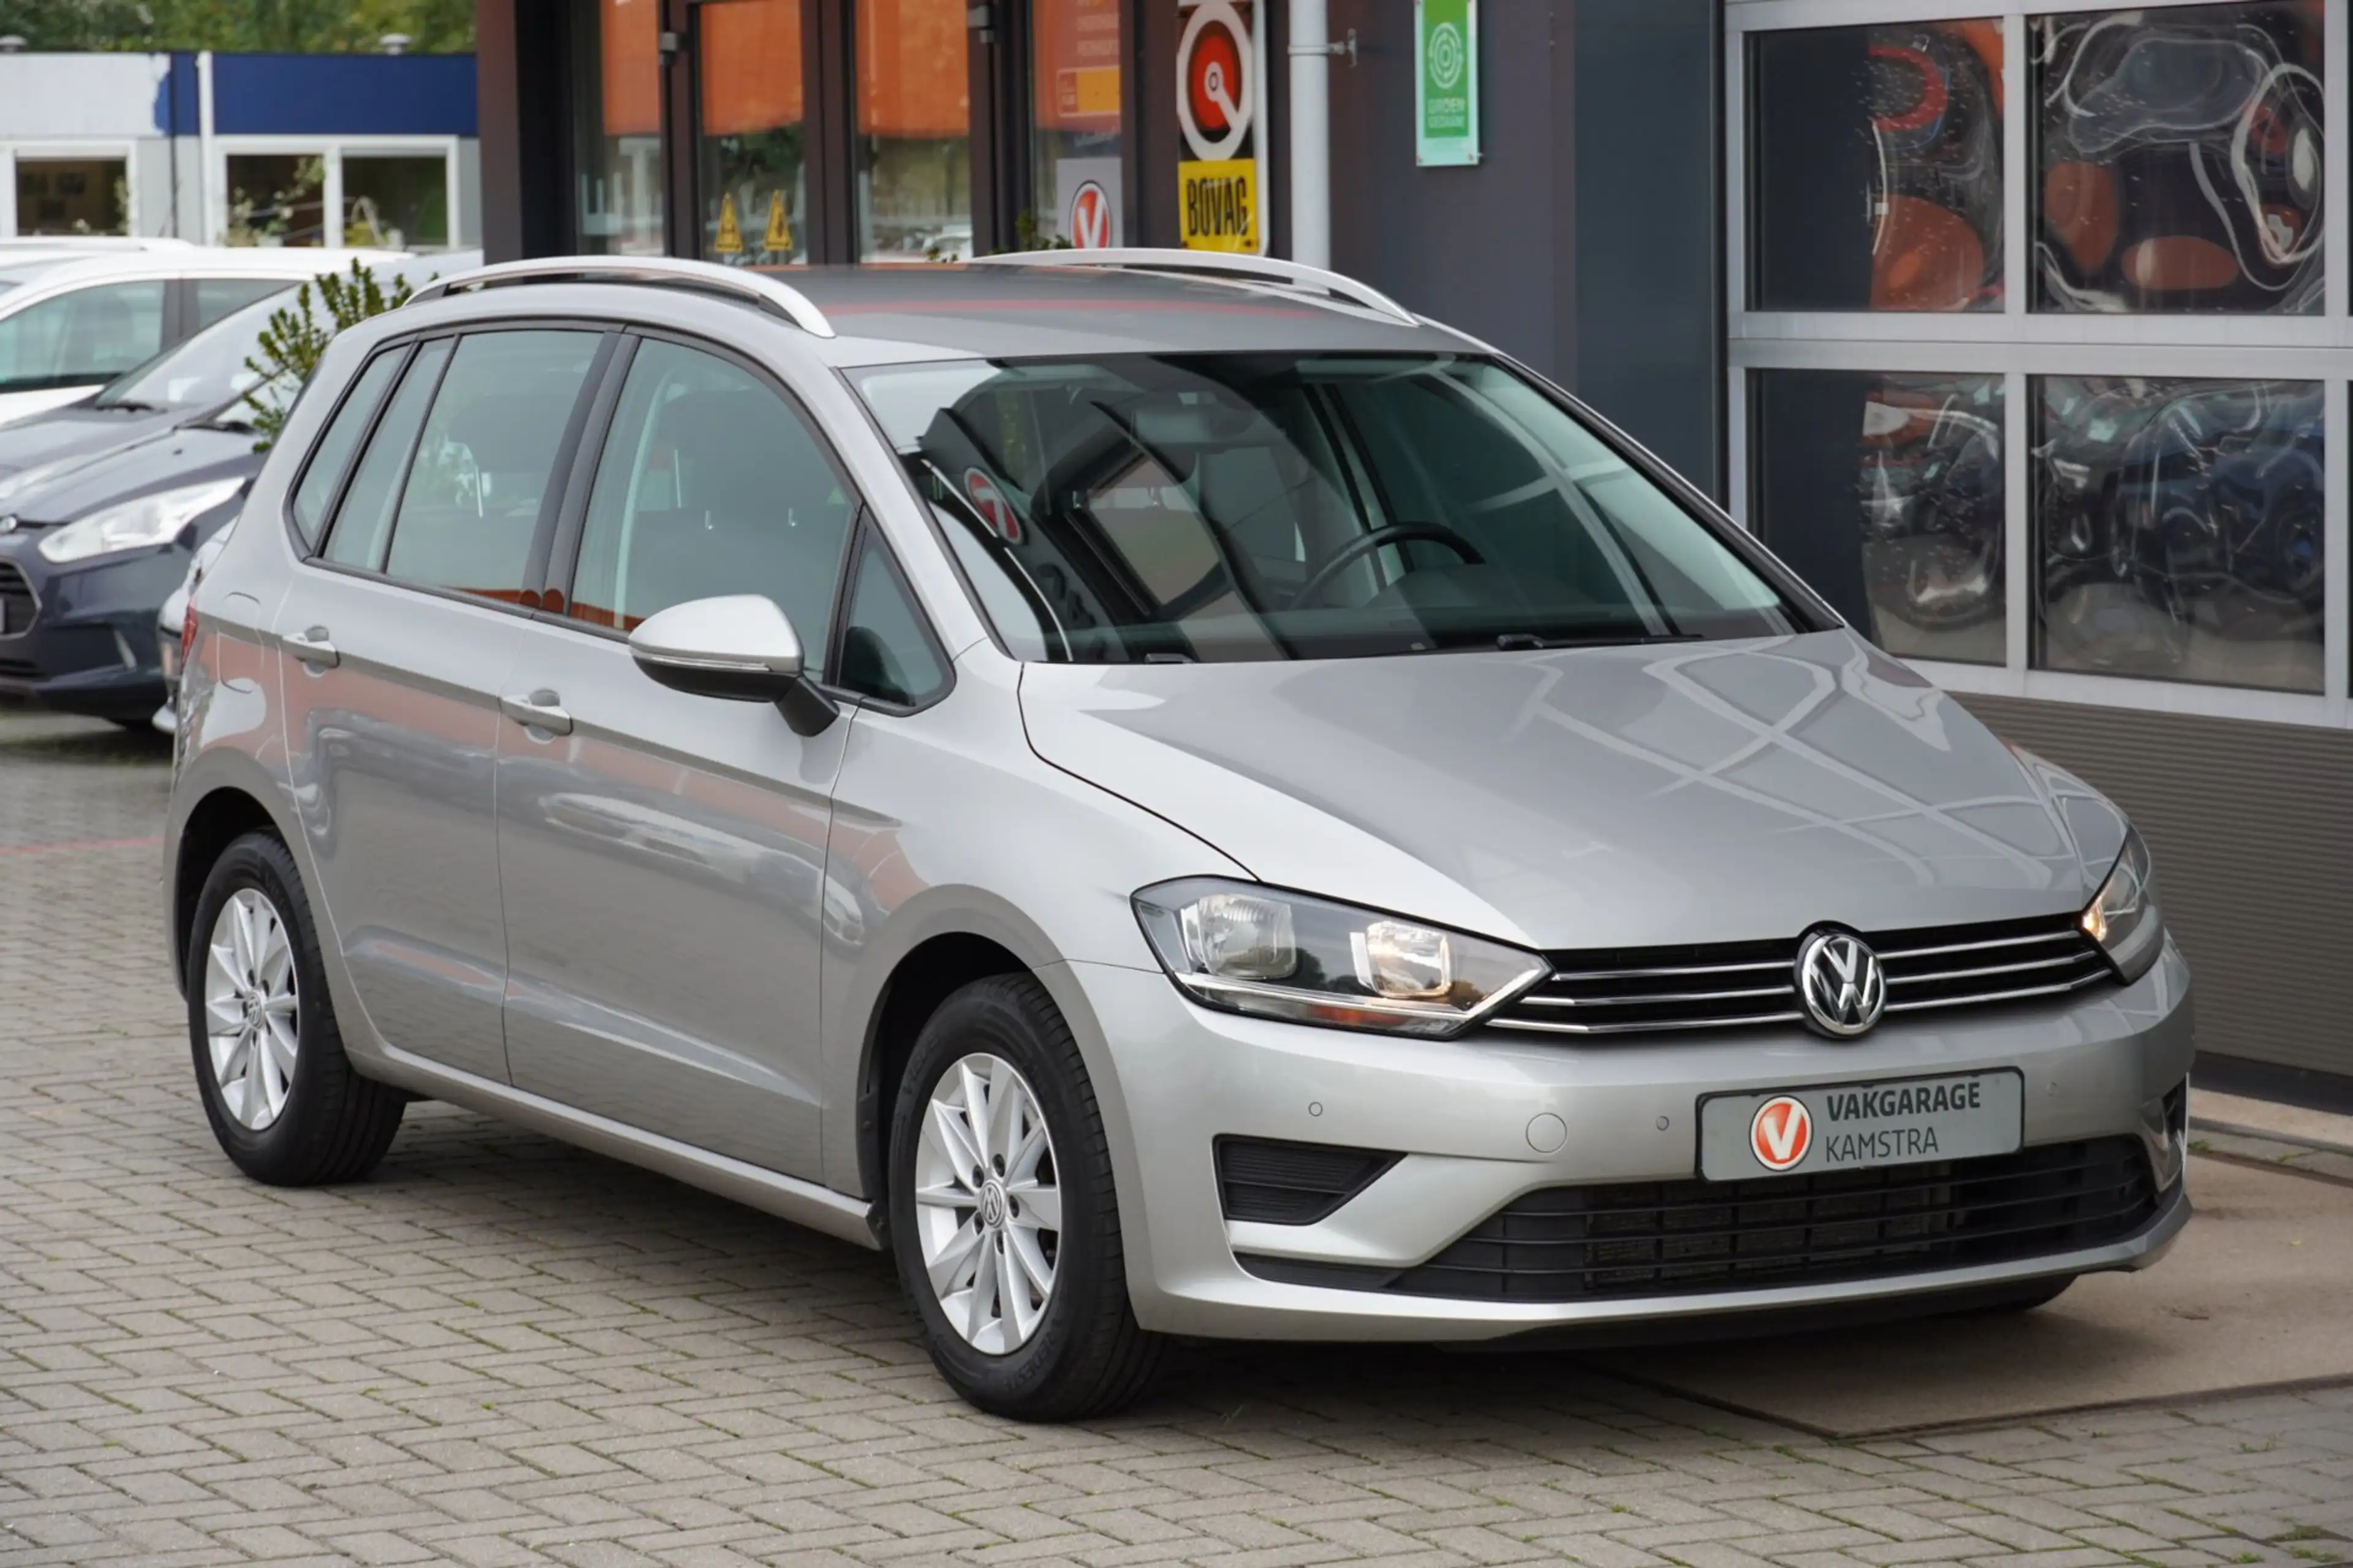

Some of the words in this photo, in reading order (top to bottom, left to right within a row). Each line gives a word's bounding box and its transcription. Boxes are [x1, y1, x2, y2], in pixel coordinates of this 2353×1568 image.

[1186, 176, 1248, 237] BOVAG
[1826, 1081, 1981, 1122] VAKGARAGE
[1761, 1101, 1805, 1161] V
[1825, 1126, 1939, 1164] KAMSTRA
